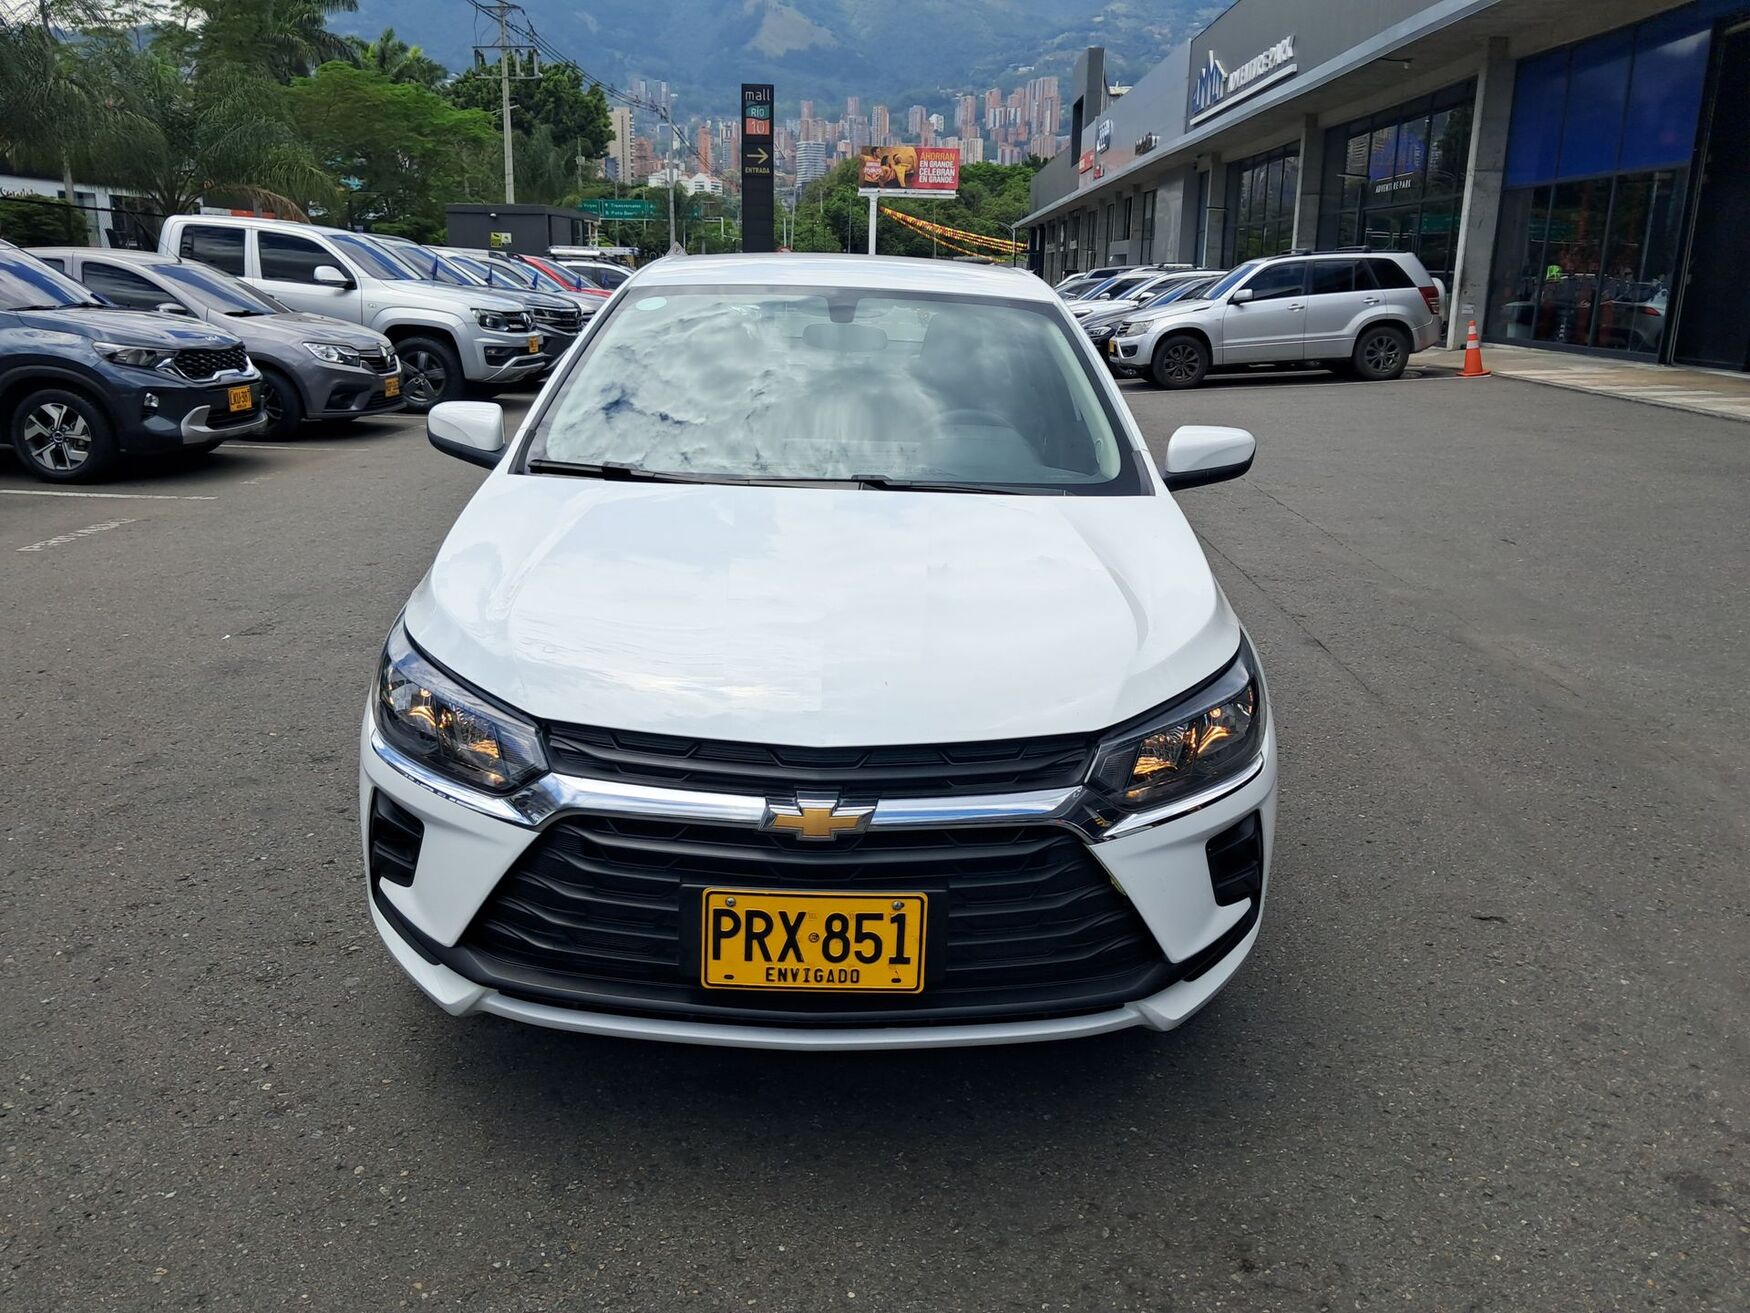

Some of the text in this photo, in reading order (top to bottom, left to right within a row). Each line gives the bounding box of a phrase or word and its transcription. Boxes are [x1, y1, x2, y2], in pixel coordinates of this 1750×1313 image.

[1268, 35, 1294, 69] PARK
[745, 88, 770, 101] mall
[751, 121, 765, 134] 10
[920, 151, 955, 160] AHORRAN
[919, 168, 955, 176] CELEBRAN
[712, 908, 911, 965] PRX 851
[765, 966, 860, 983] ENVIGADO
